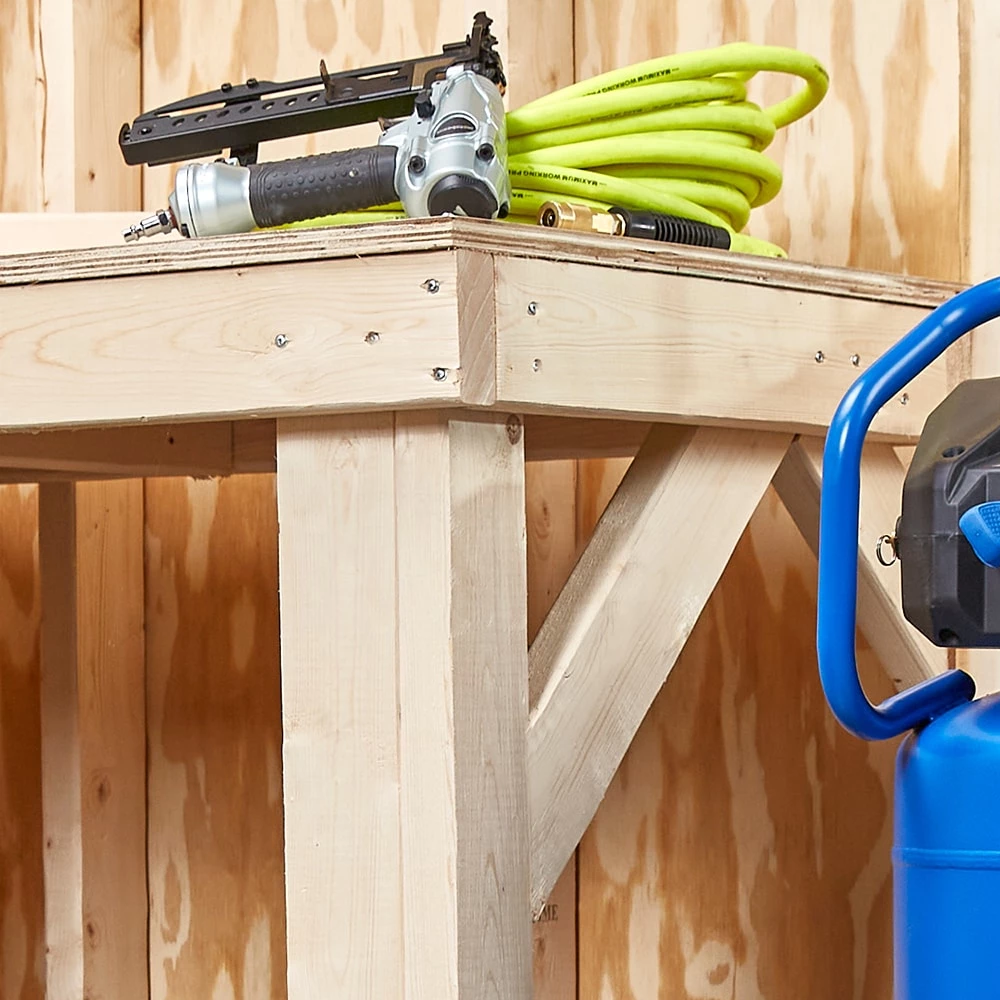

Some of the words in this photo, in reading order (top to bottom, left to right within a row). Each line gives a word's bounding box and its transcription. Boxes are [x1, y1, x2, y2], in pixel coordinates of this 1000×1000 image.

[637, 68, 671, 82] MAXIMUM
[602, 77, 637, 93] WORKING
[523, 169, 561, 179] WORKING
[562, 174, 598, 186] MAXIMUM
